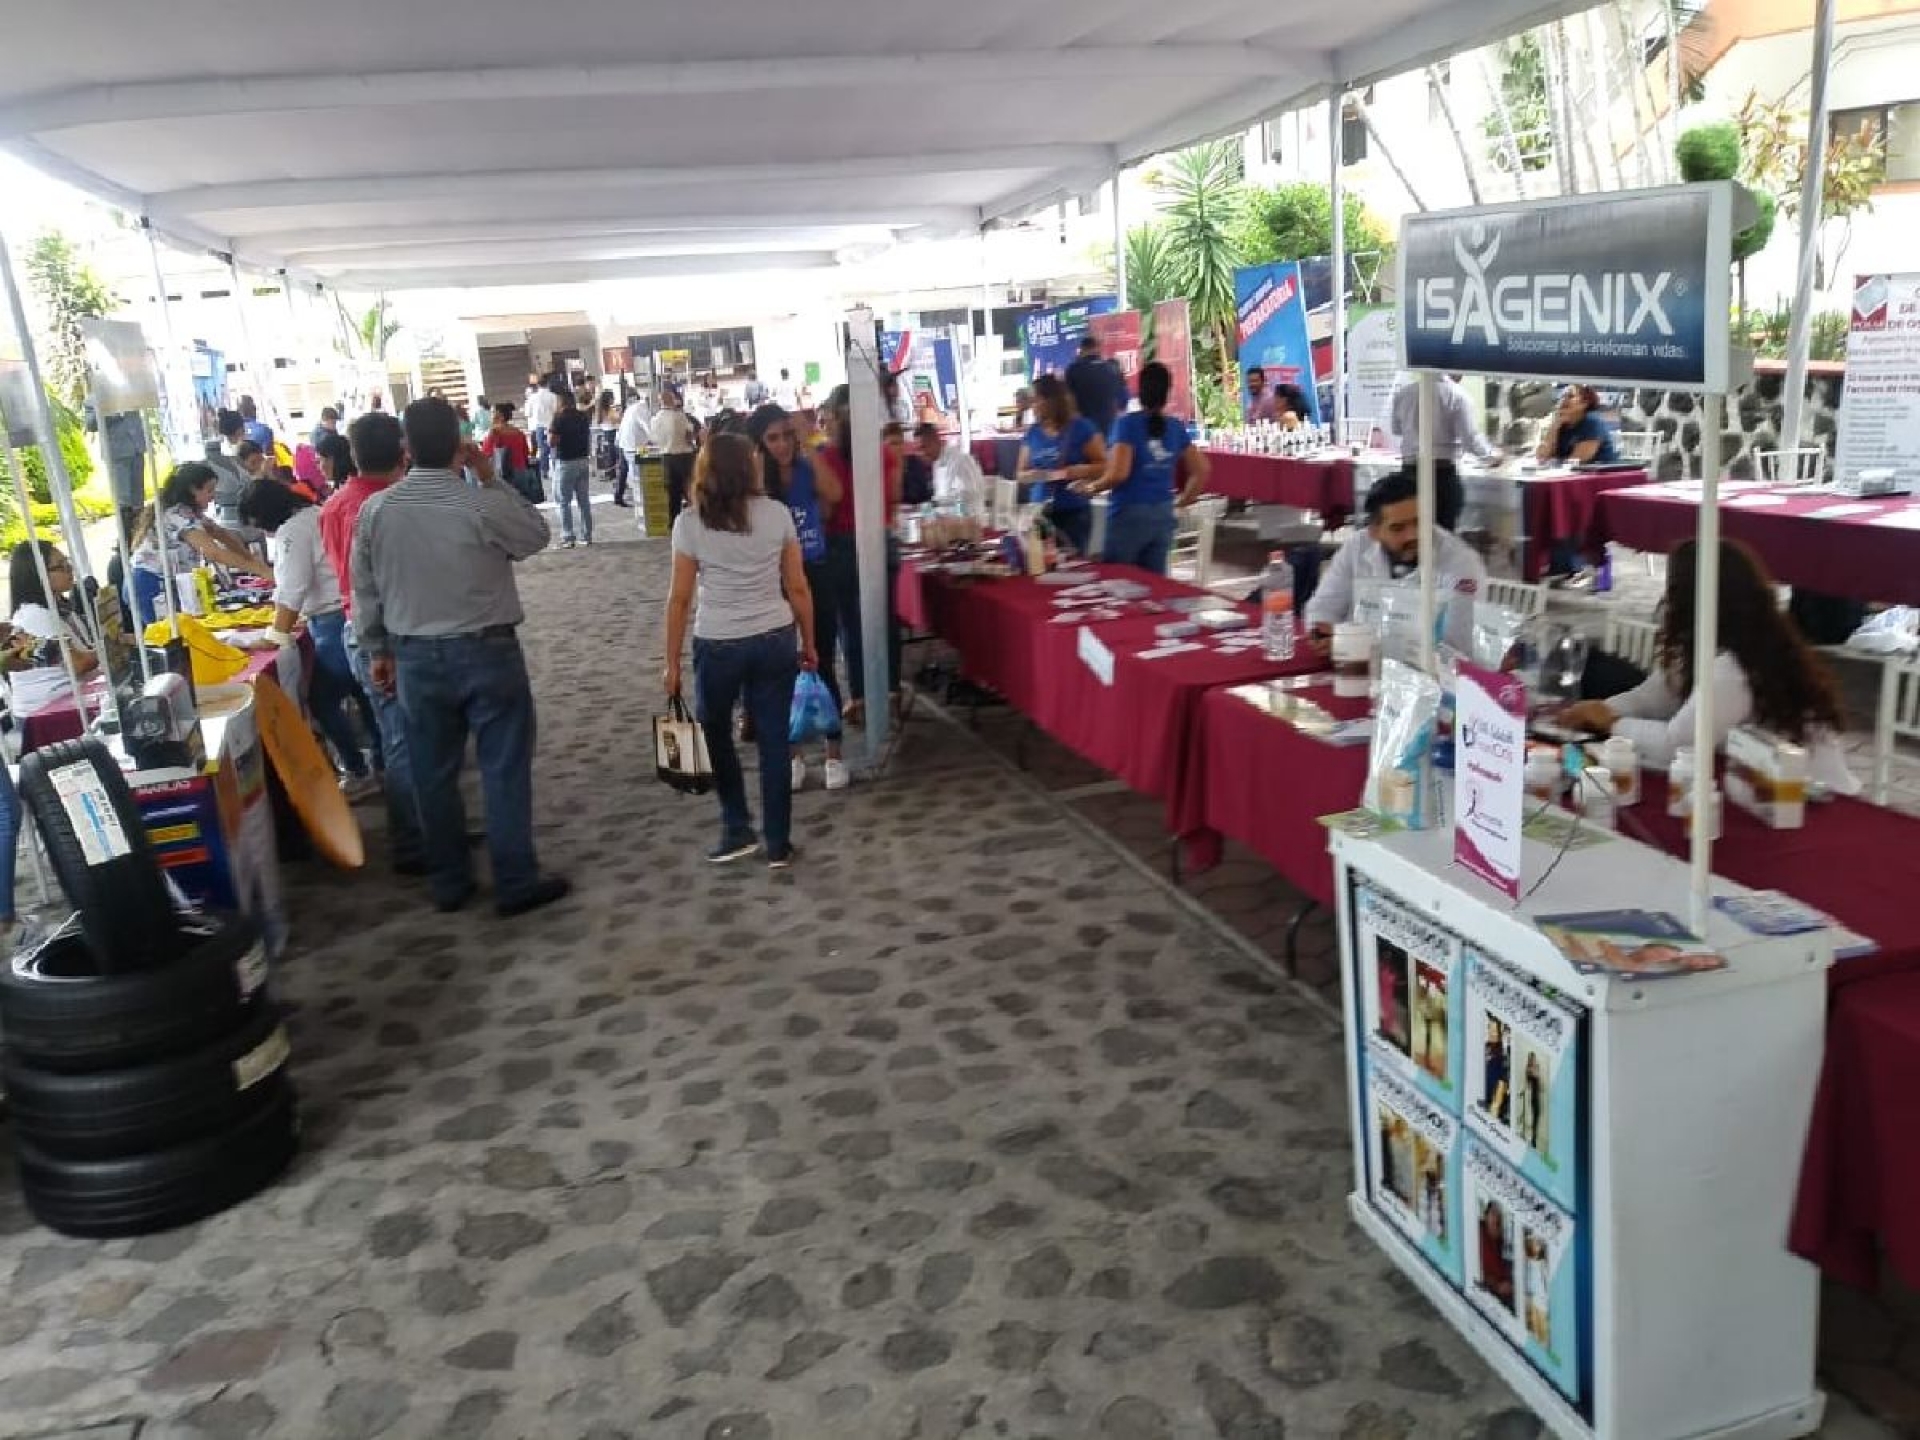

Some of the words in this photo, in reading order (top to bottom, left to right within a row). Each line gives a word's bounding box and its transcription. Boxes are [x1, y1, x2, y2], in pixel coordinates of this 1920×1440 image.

[1416, 268, 1675, 346] ISAGENIX
[1507, 336, 1560, 352] Soluciones
[1562, 340, 1581, 357] que
[1583, 338, 1649, 357] transforman
